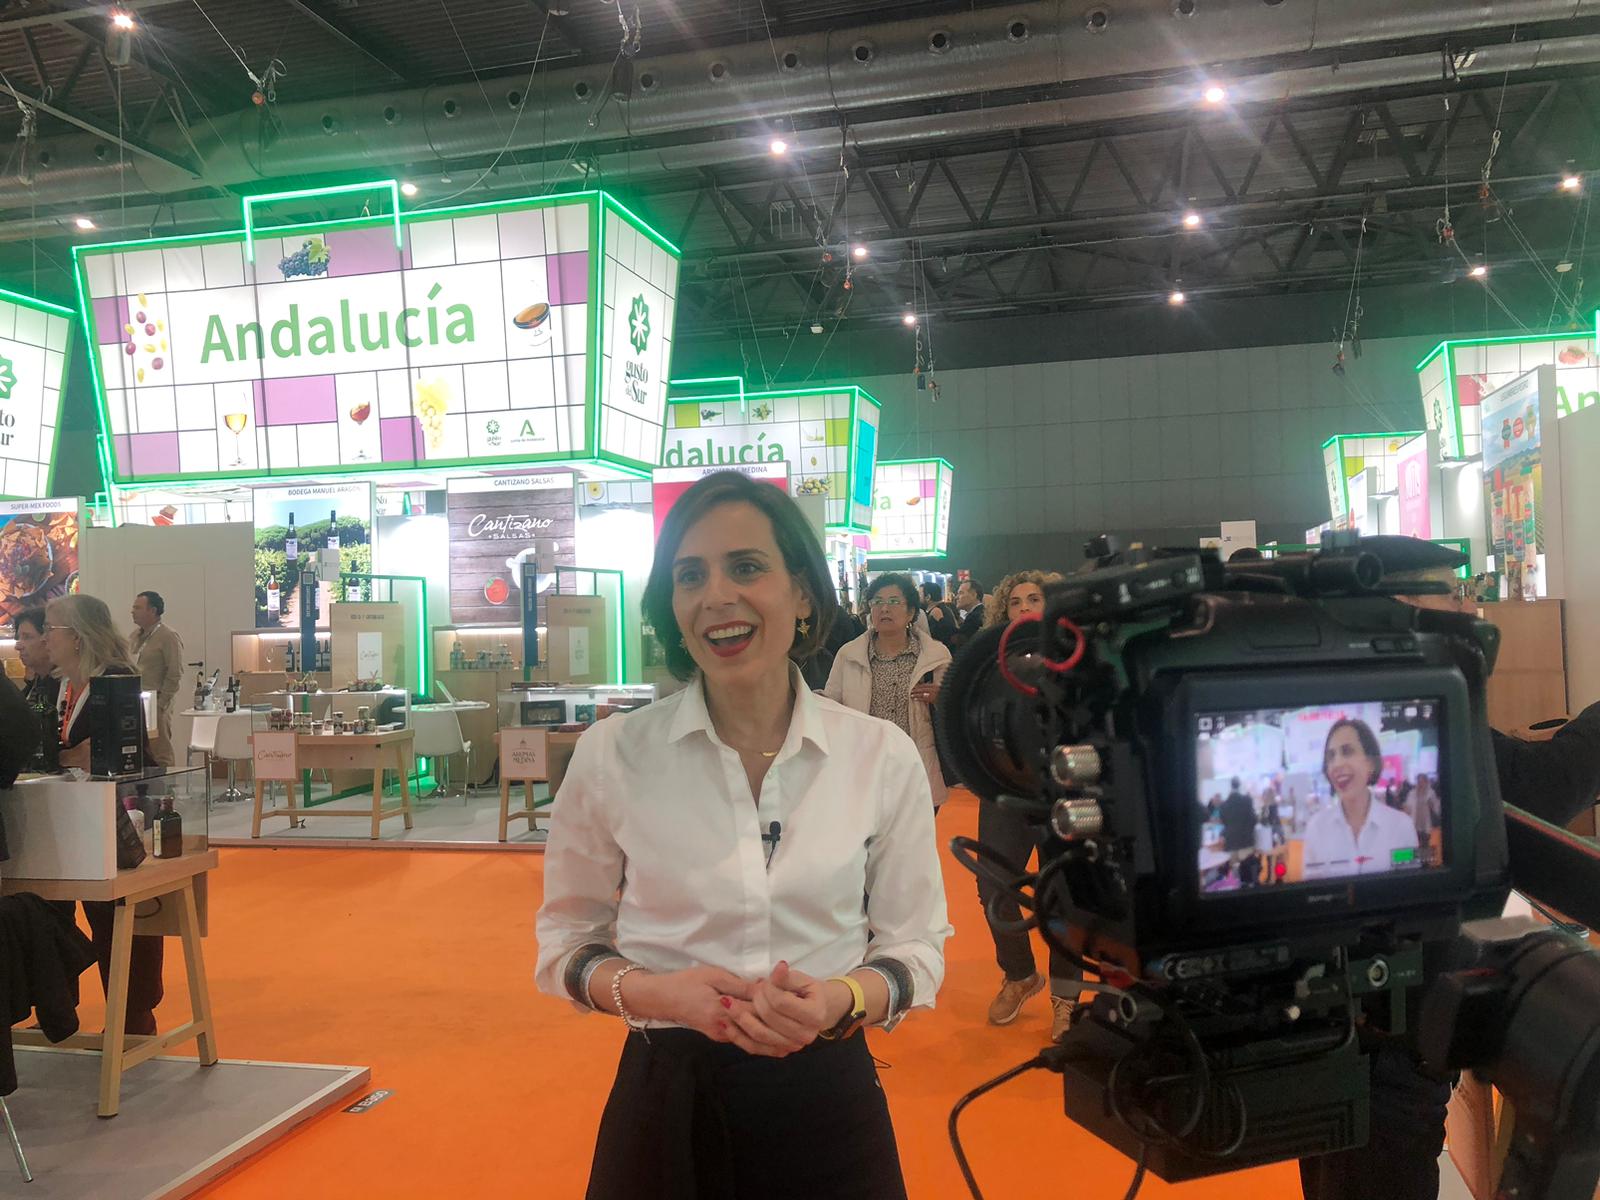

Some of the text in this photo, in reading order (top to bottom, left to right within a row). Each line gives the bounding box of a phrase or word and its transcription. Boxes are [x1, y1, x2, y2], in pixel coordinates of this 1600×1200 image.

[200, 282, 475, 363] Andalucía
[624, 360, 648, 384] gusto
[631, 379, 648, 405] Sur
[494, 477, 554, 487] CANTIZANO SALSAS
[468, 513, 553, 537] Cantizano
